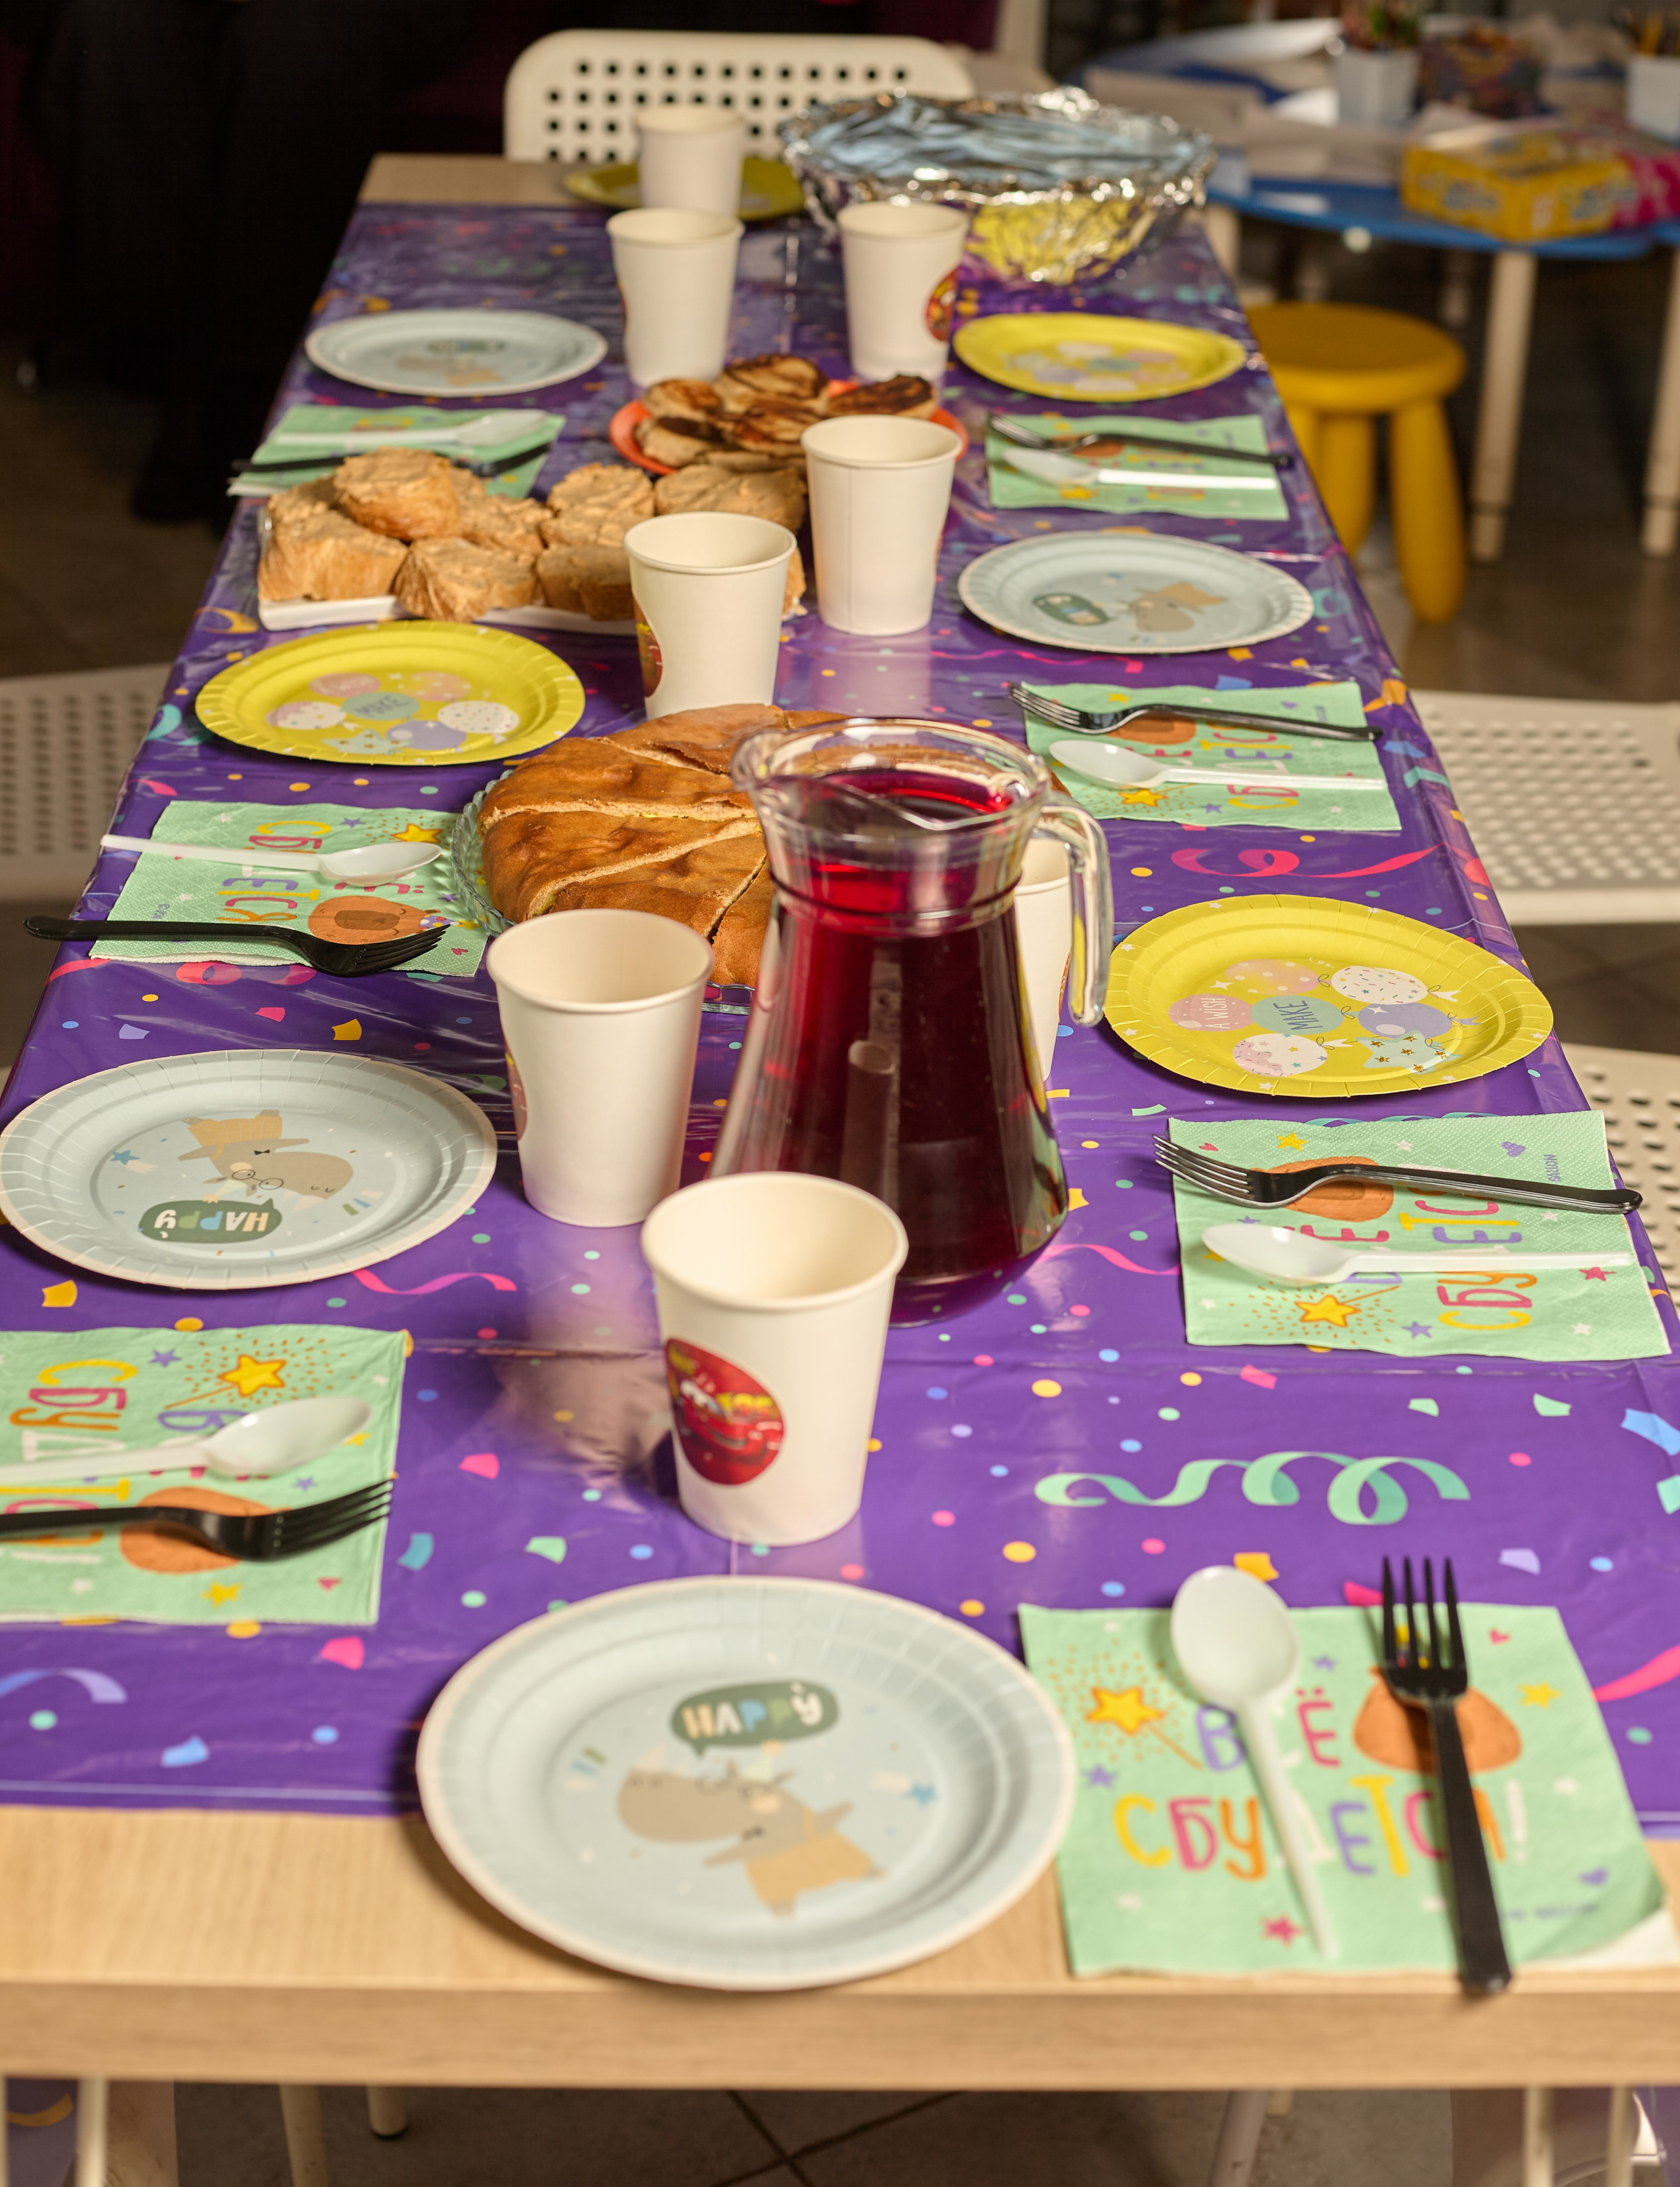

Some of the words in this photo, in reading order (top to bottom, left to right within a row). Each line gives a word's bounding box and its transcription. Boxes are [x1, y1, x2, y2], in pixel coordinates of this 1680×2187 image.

[1200, 997, 1229, 1020] WISH
[1272, 1000, 1324, 1030] MAKE
[1194, 1686, 1341, 1772] ВЁ
